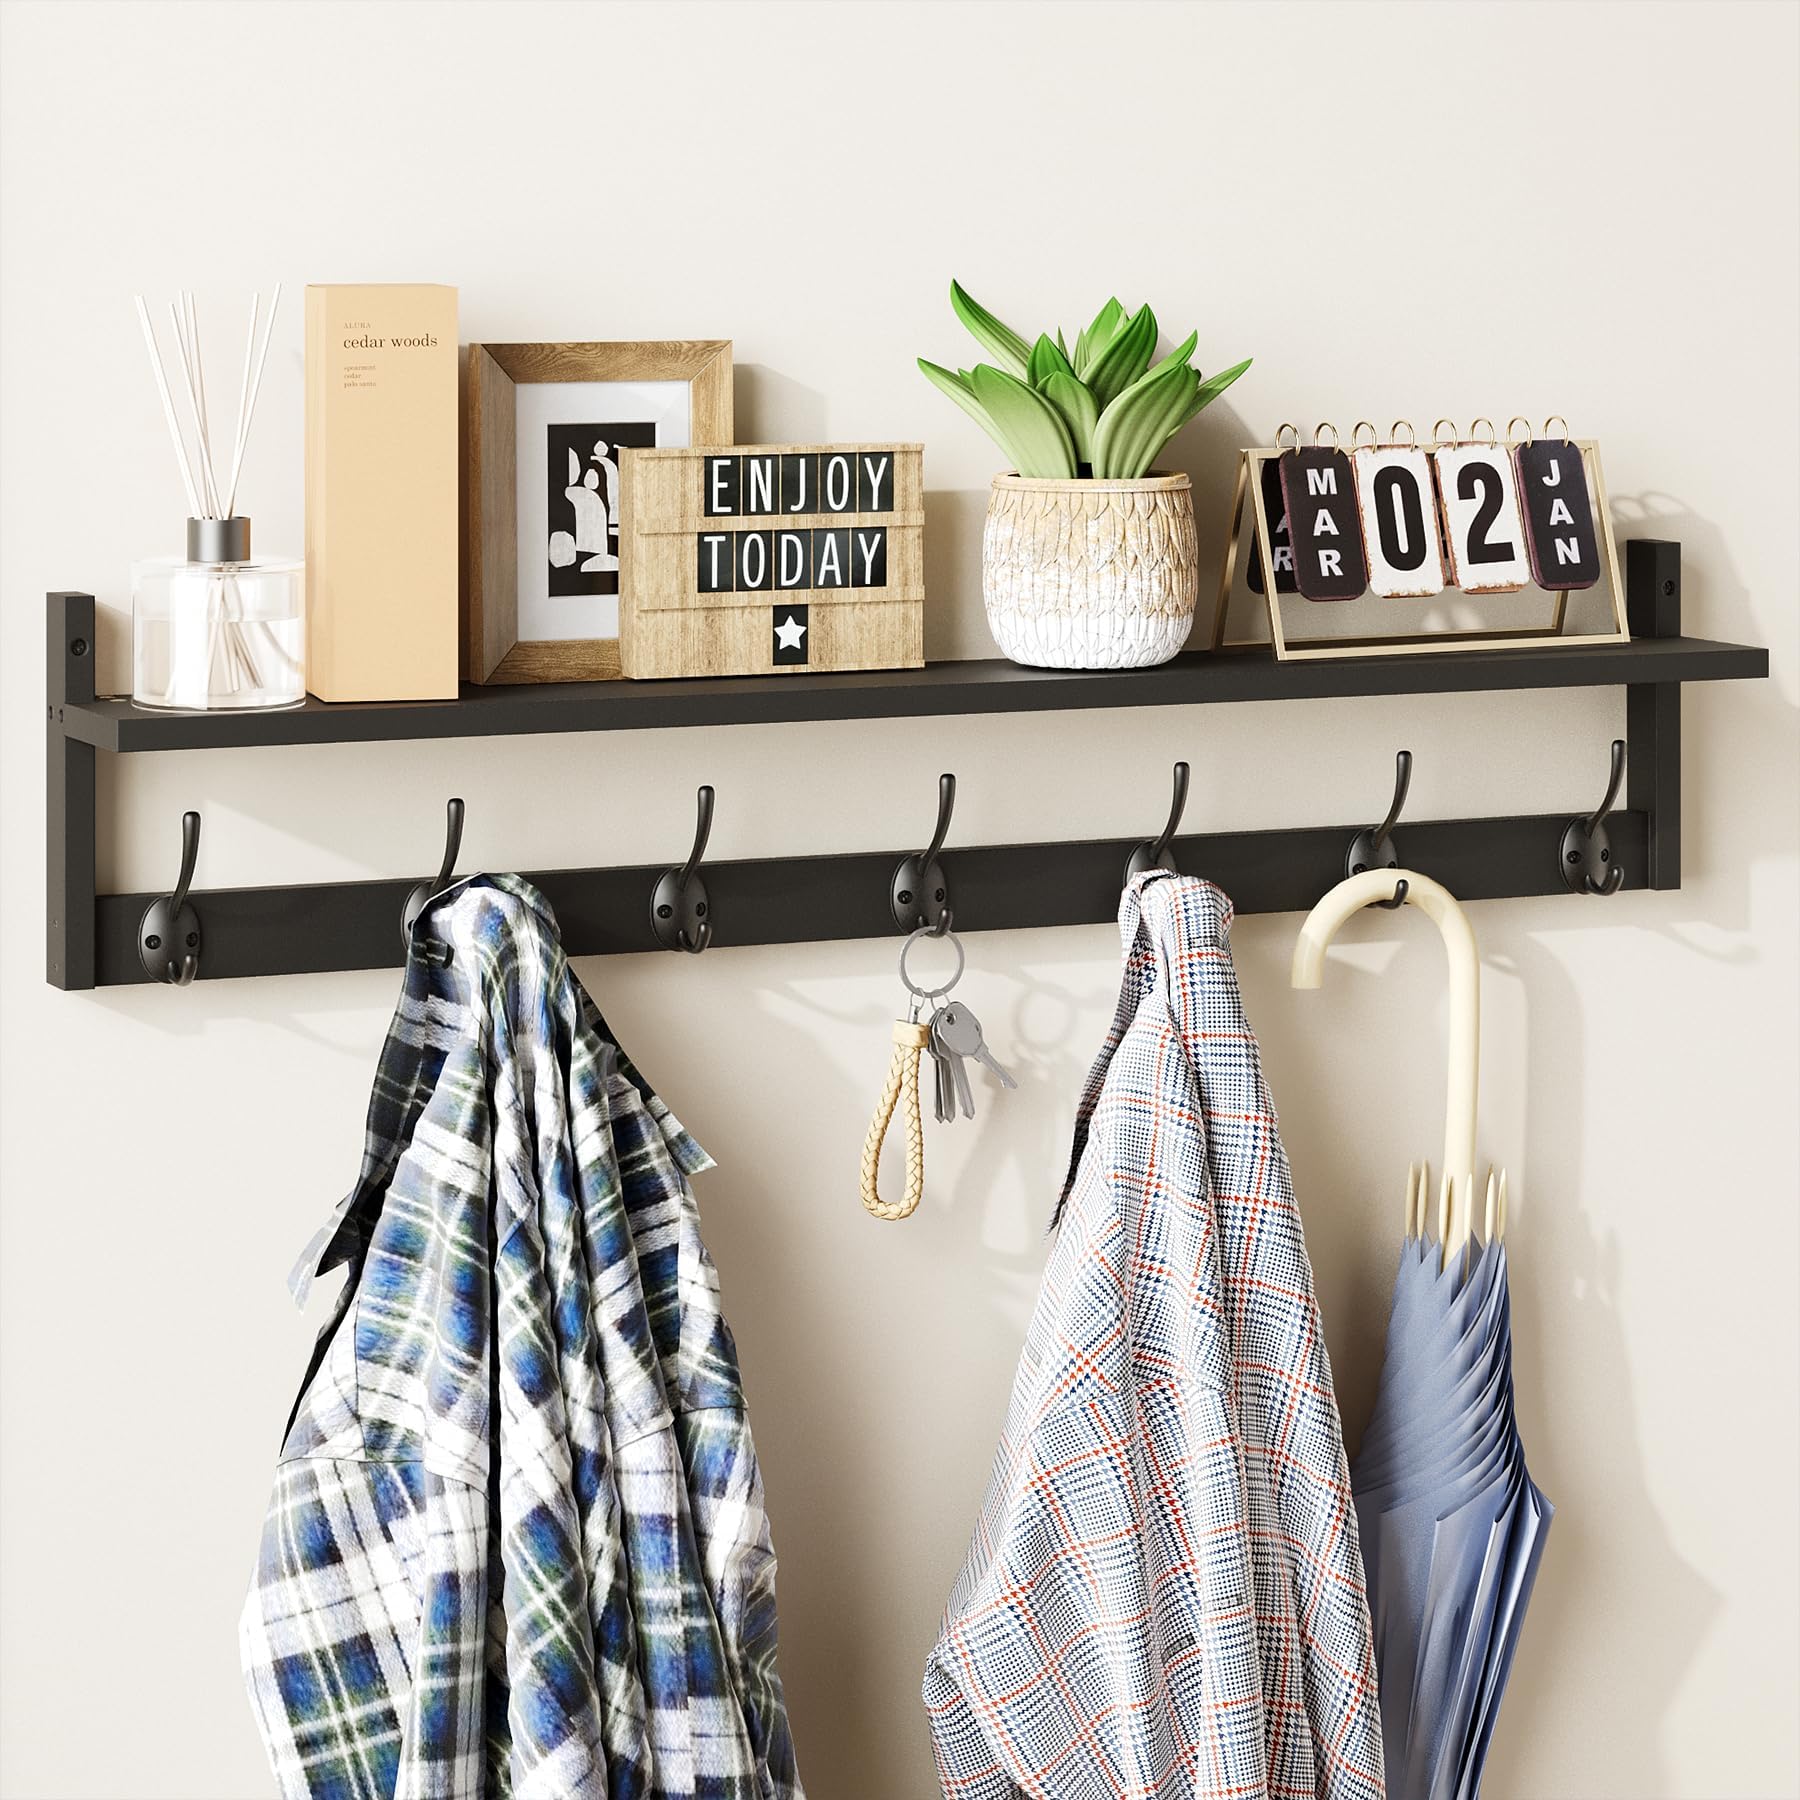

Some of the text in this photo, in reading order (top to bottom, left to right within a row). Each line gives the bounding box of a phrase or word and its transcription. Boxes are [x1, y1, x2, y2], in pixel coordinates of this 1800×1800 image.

[343, 333, 438, 349] cedar woods
[712, 456, 888, 513] ENJOY
[1541, 459, 1581, 565] JAN
[1306, 467, 1345, 577] MAR
[703, 532, 882, 589] TODAY
